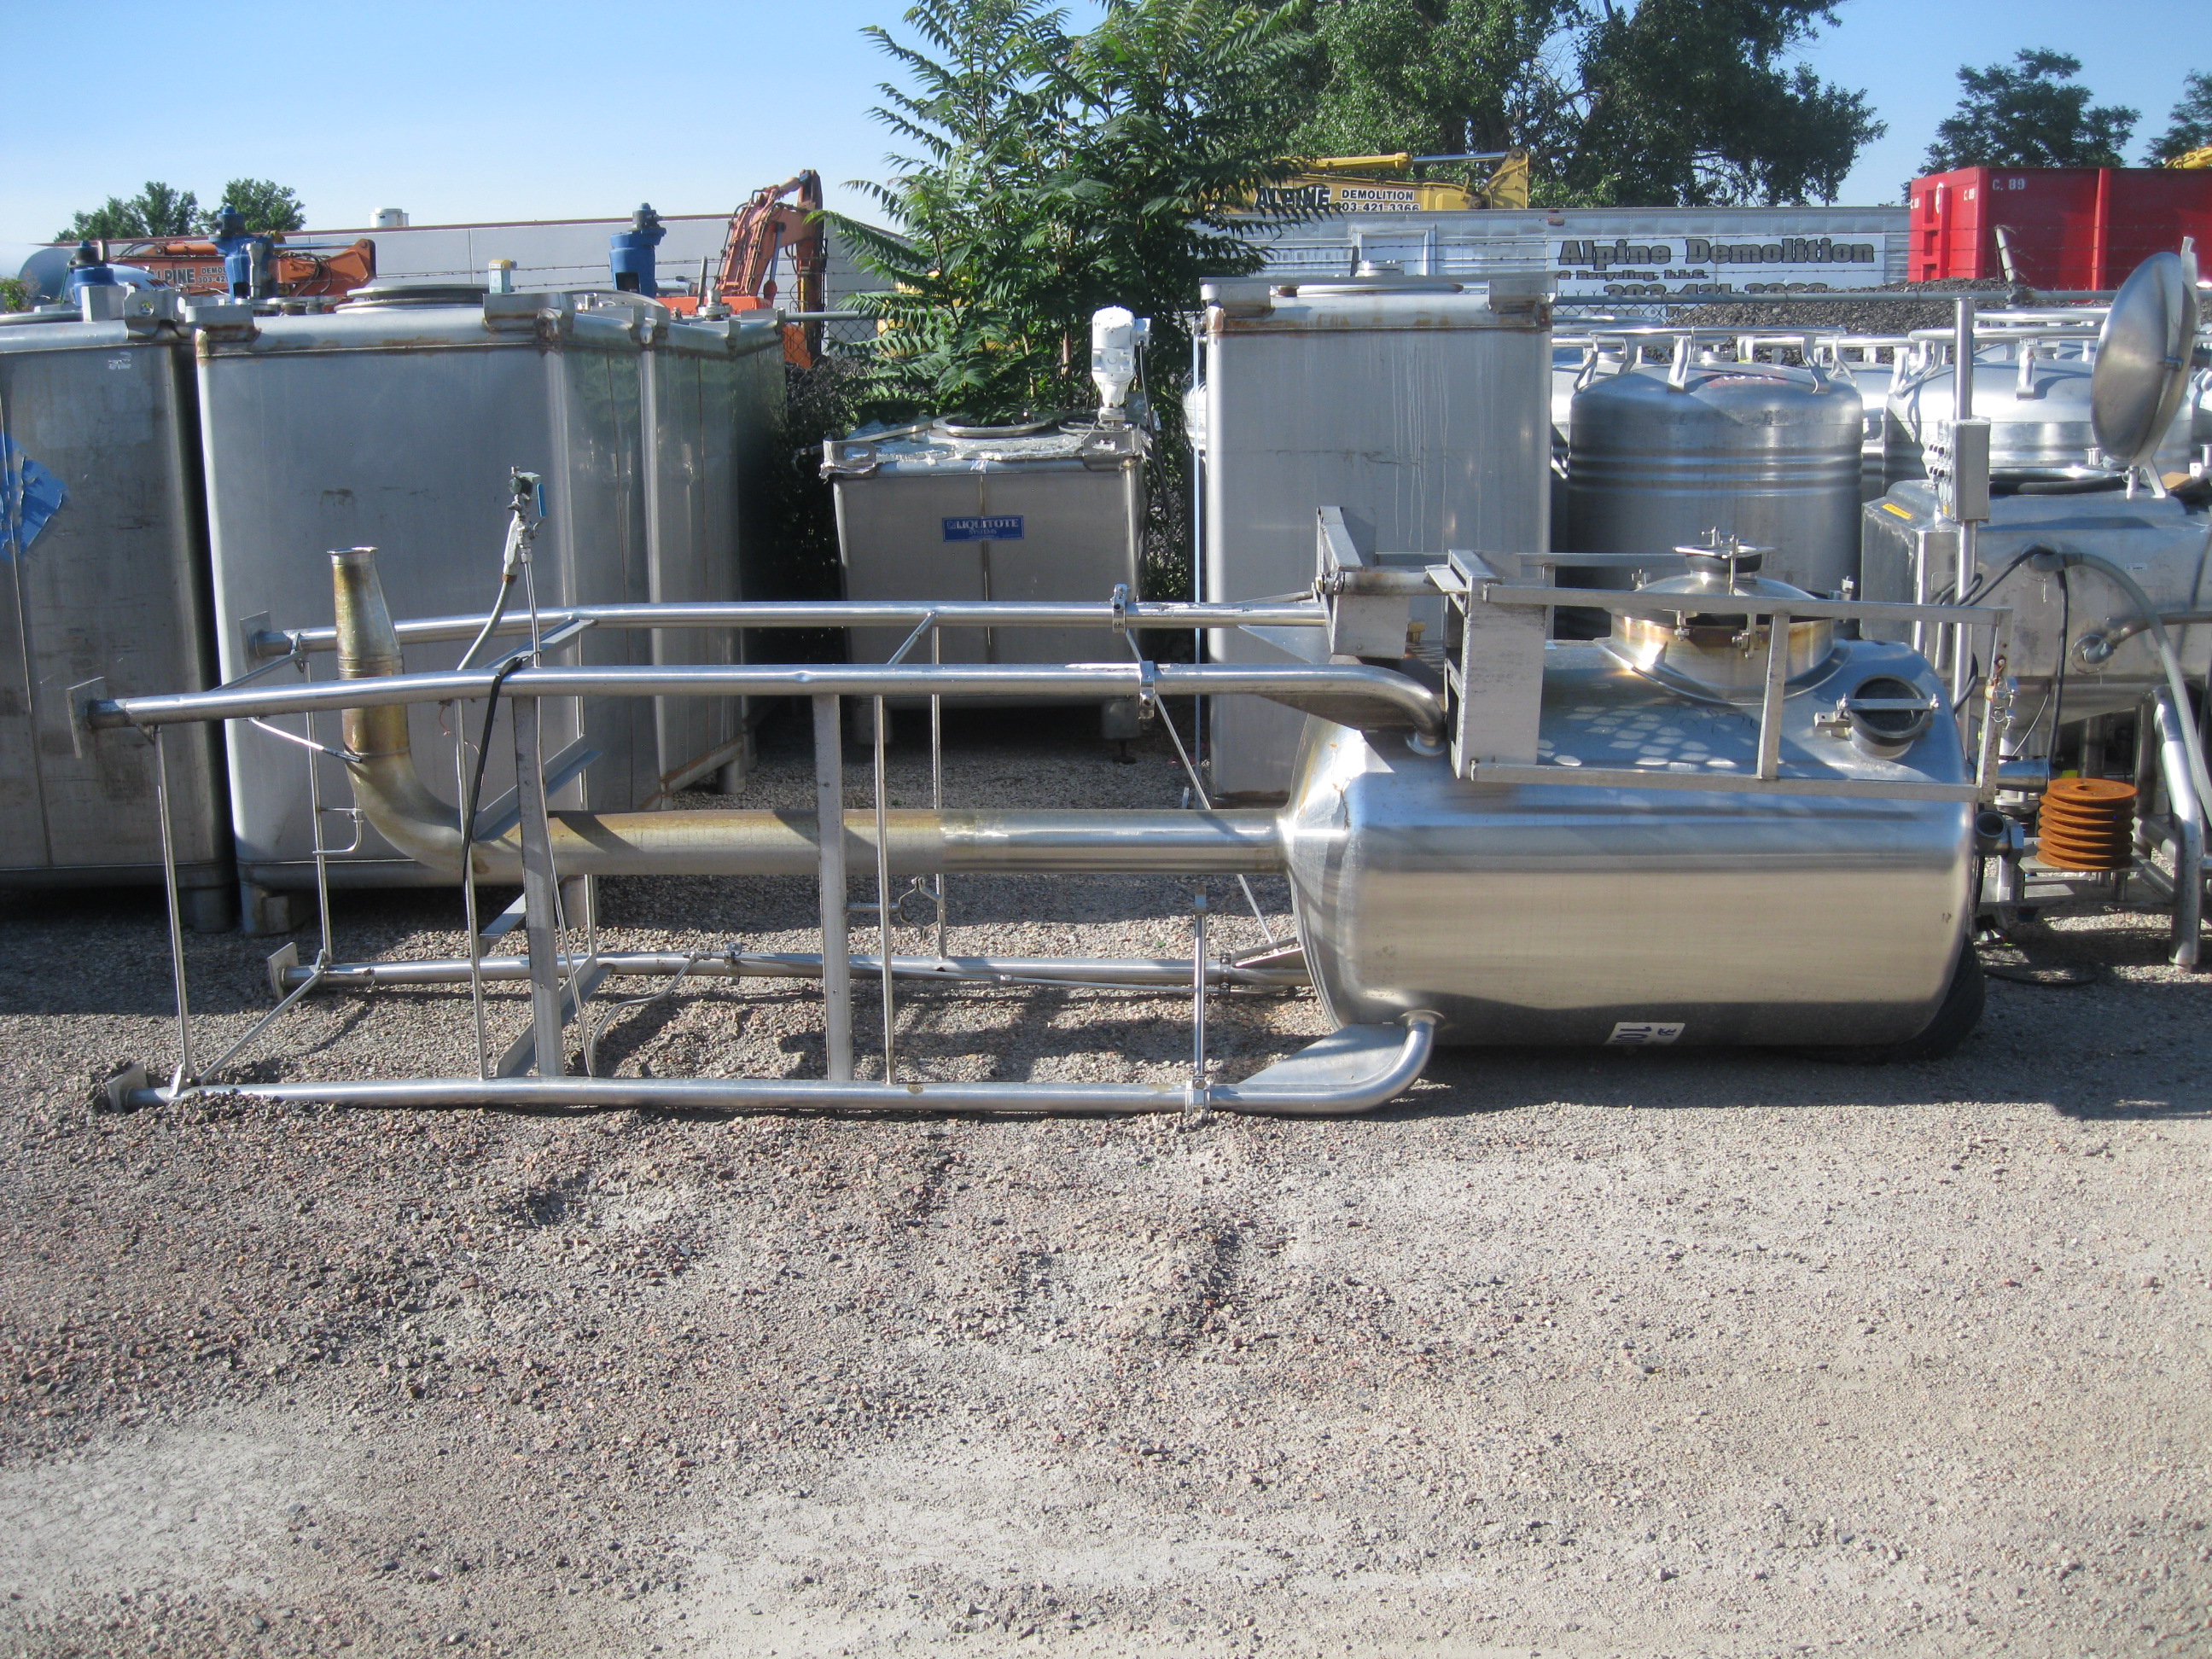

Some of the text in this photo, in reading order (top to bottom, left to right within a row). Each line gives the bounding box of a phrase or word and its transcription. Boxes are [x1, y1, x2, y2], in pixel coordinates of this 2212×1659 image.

[2008, 178, 2025, 190] 89
[1341, 189, 1414, 201] DEMOLITION
[1558, 237, 1875, 271] Alpine Demolition
[1576, 270, 1660, 282] Recycling,
[956, 519, 1019, 529] LIQUITOTE
